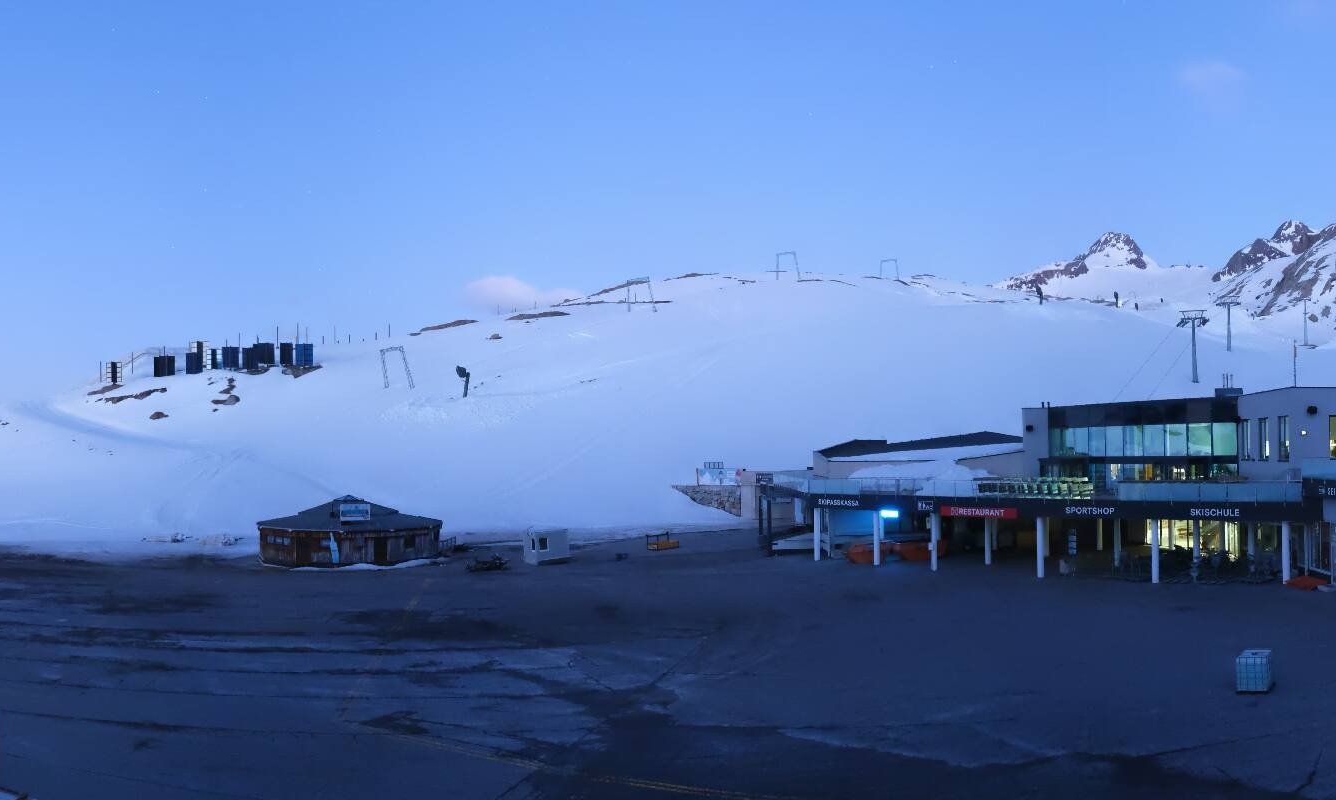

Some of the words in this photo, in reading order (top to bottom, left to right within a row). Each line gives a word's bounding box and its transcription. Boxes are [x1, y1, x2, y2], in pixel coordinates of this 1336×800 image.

[818, 498, 860, 508] SKIPASSKASSA
[958, 507, 1005, 517] RESTAURANT
[1065, 506, 1115, 516] SPORTSHOP
[1189, 508, 1240, 517] SKISCHULE
